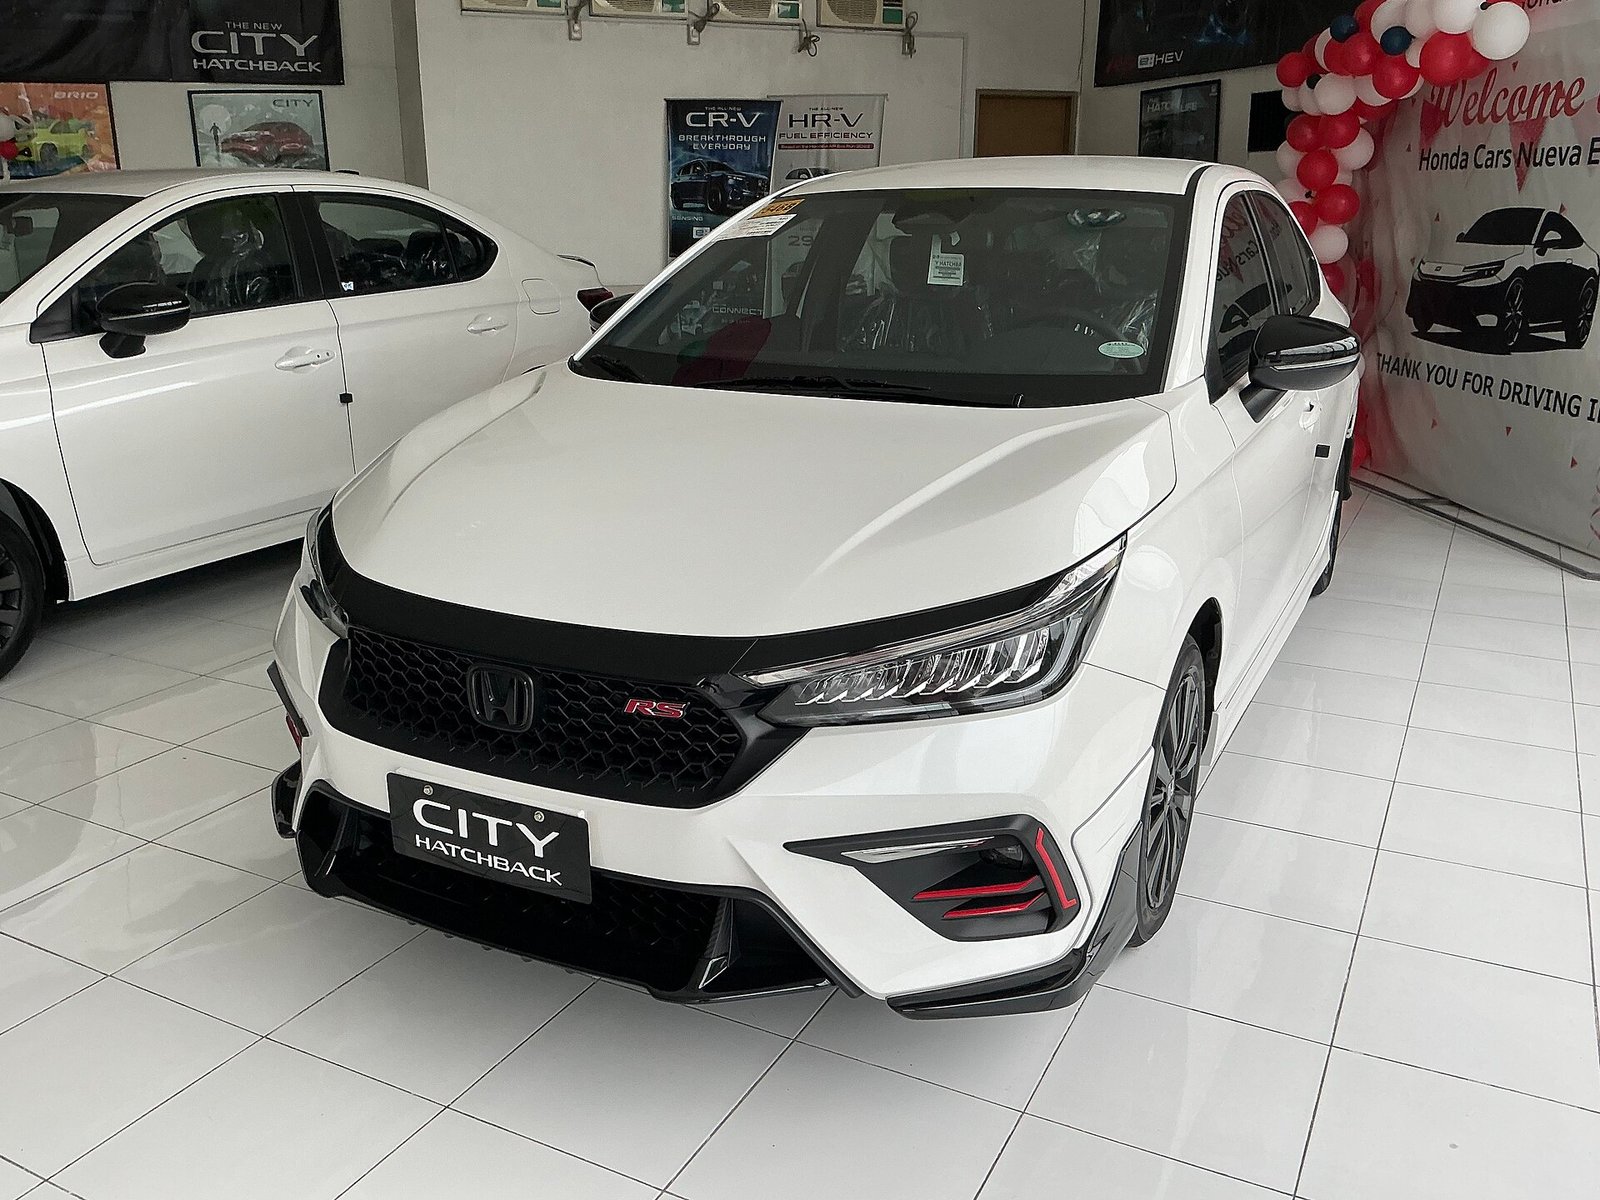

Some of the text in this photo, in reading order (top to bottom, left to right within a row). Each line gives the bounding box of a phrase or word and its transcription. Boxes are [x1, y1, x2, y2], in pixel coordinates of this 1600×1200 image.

[225, 21, 282, 30] THE NEW
[191, 30, 318, 57] CITY
[193, 58, 322, 73] HATCHBACK
[54, 91, 99, 100] BRIO
[272, 99, 313, 108] CITY
[1430, 68, 1586, 128] Welcome
[686, 112, 761, 128] CR-V
[788, 113, 864, 128] HR-V
[678, 134, 766, 142] BREAKTHROUGH
[692, 143, 751, 151] EVERYDAY
[1419, 145, 1470, 171] Honda
[1473, 144, 1512, 169] Cars
[1517, 141, 1583, 168] Nueva
[1377, 352, 1422, 380] THANK
[1426, 362, 1459, 388] YOU
[1462, 371, 1494, 397] FOR
[1499, 379, 1582, 417] DRIVING
[623, 698, 691, 719] RS
[412, 798, 560, 859] CITY
[415, 833, 563, 887] HATCHBACK
